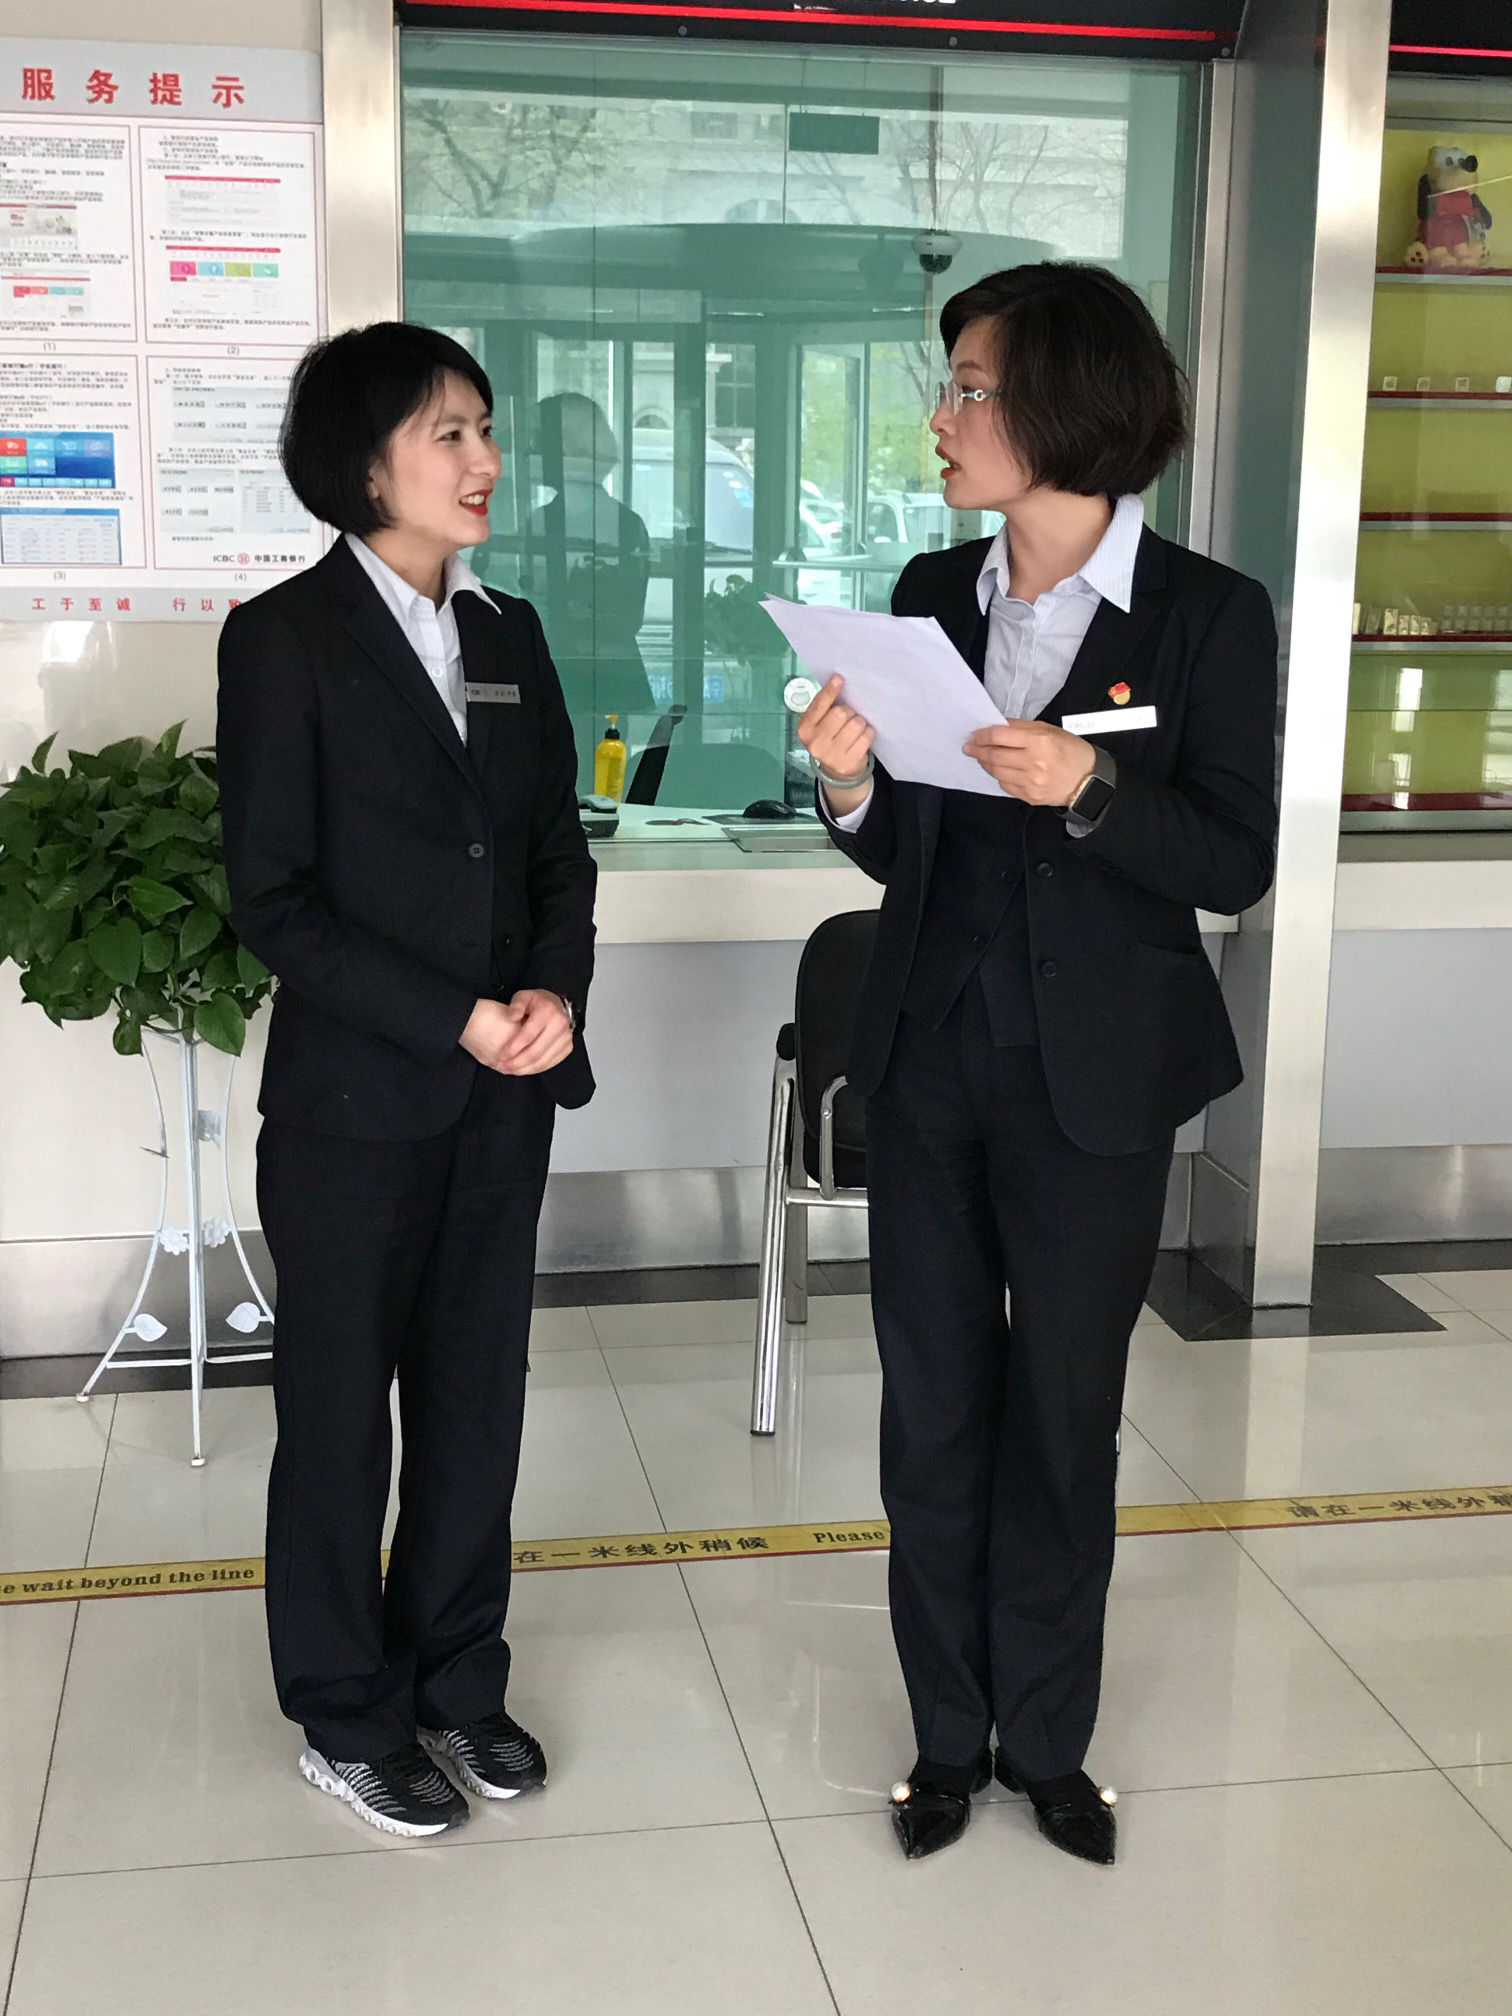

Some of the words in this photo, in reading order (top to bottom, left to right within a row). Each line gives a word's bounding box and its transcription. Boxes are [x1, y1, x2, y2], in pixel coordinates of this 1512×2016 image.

[22, 67, 245, 108] 服务提示
[227, 346, 240, 355] (2)
[213, 554, 235, 563] ICBC
[53, 571, 67, 581] (3)
[234, 572, 247, 582] (4)
[32, 597, 131, 612] 工于至诚
[513, 1536, 769, 1563] 在一米线外稍候
[813, 1529, 885, 1544] Please
[23, 1578, 74, 1593] wait
[81, 1573, 162, 1590] beyond
[168, 1571, 205, 1584] the
[212, 1568, 255, 1580] line
